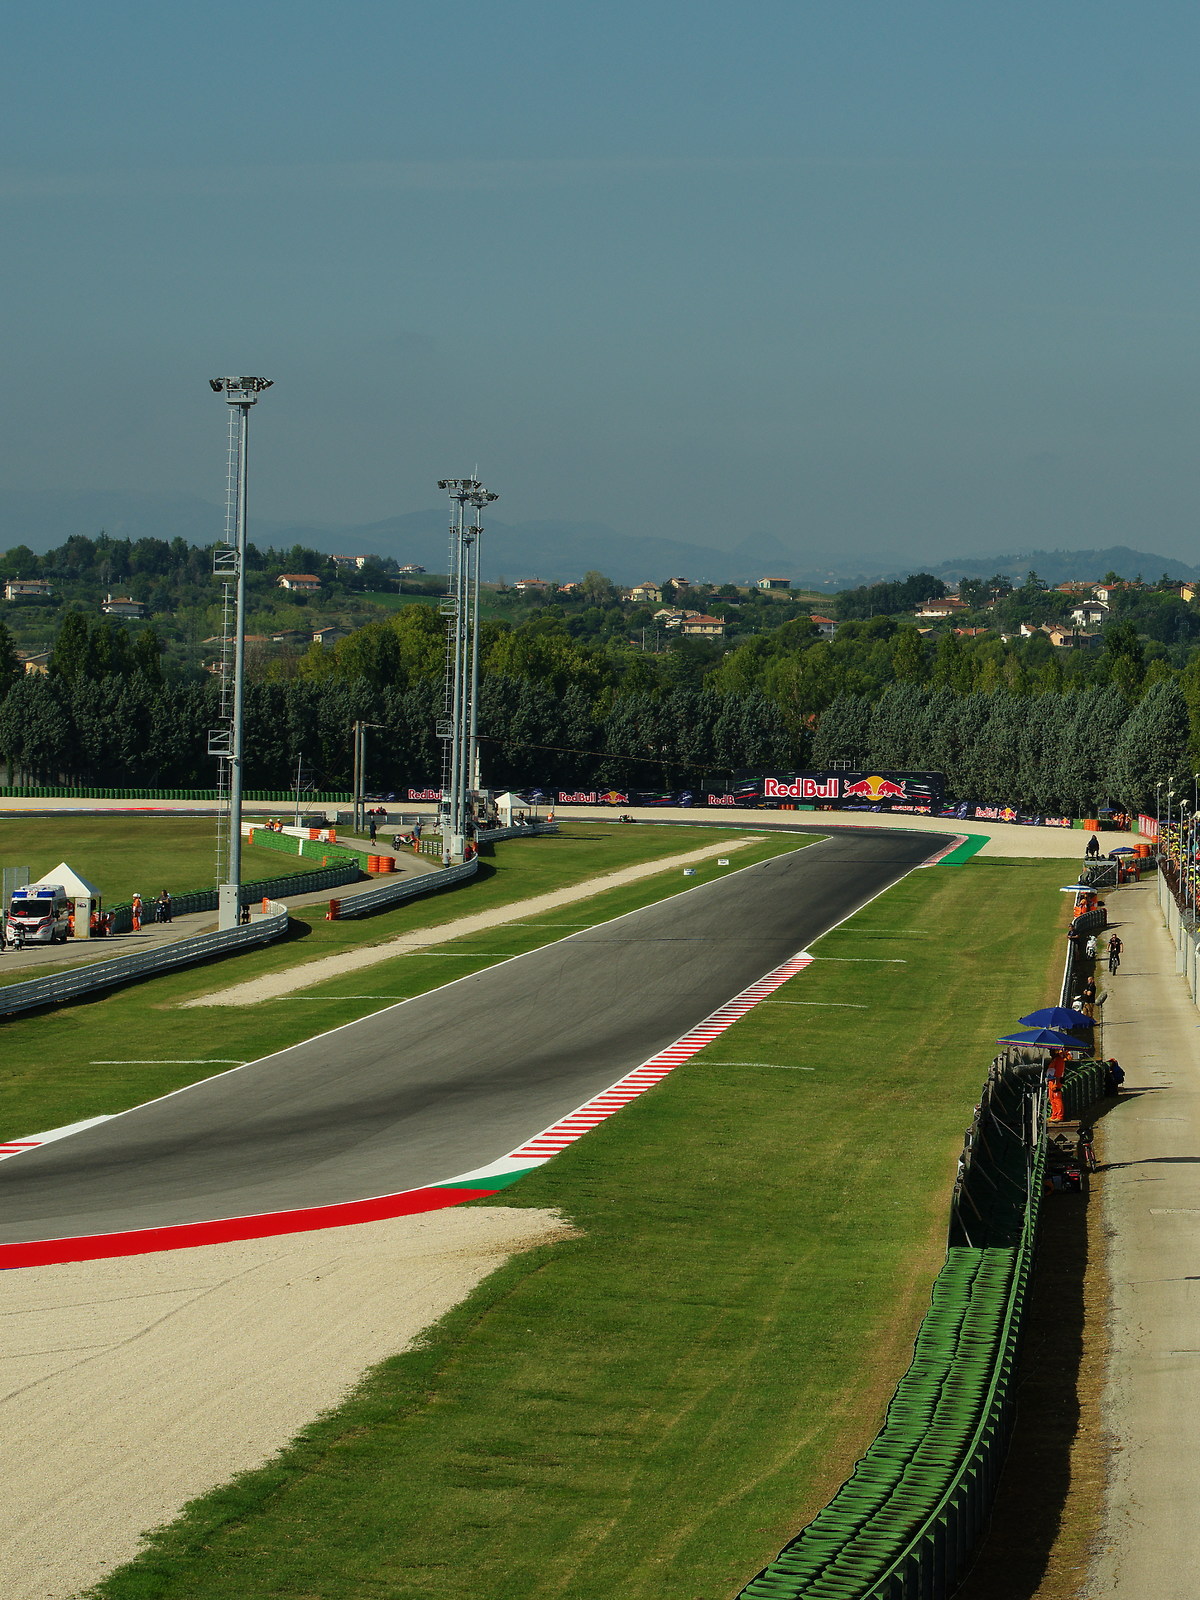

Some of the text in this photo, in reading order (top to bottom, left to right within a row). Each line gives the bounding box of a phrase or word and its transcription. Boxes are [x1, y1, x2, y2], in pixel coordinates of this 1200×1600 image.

[764, 778, 839, 798] Red Bull
[408, 789, 428, 799] Red
[558, 792, 597, 803] Red Bull
[708, 794, 727, 805] Red
